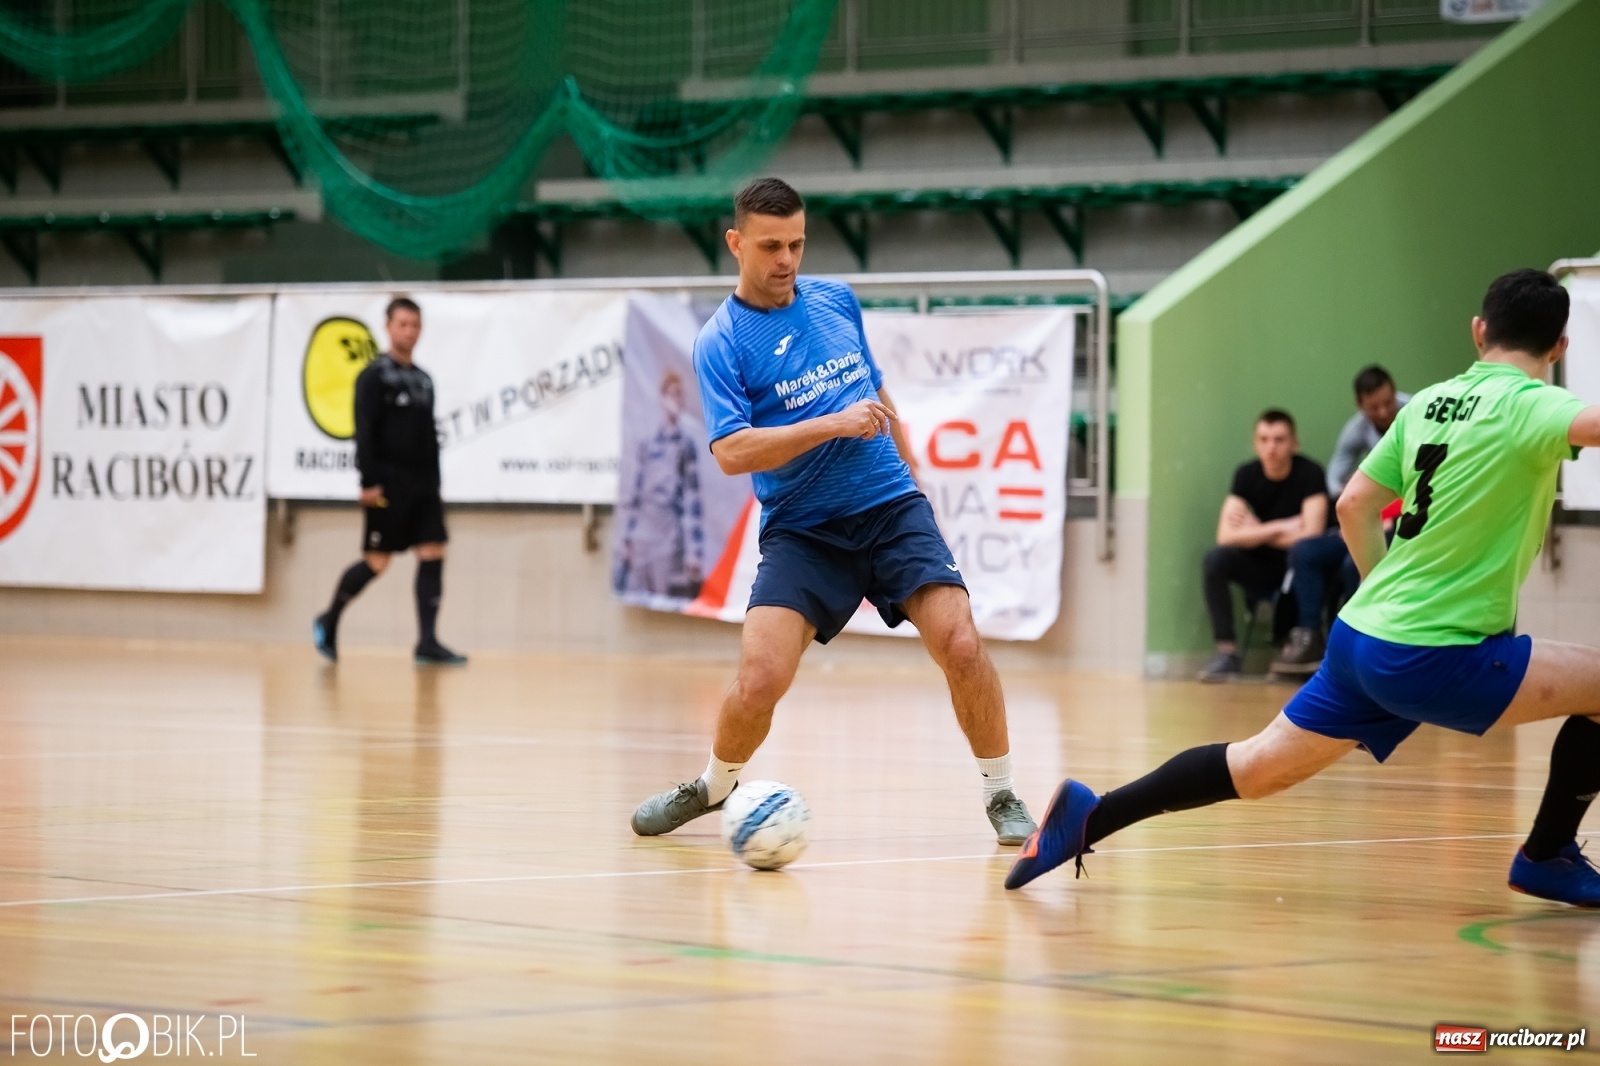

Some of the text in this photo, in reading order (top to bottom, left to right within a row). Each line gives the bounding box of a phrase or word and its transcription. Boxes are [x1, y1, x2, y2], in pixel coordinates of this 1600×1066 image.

[775, 351, 863, 398] Marek&Dariu
[923, 345, 1047, 377] WORK
[77, 381, 229, 430] MIASTO
[784, 376, 841, 411] Metallbau
[51, 438, 255, 502] RACIBÓRZ
